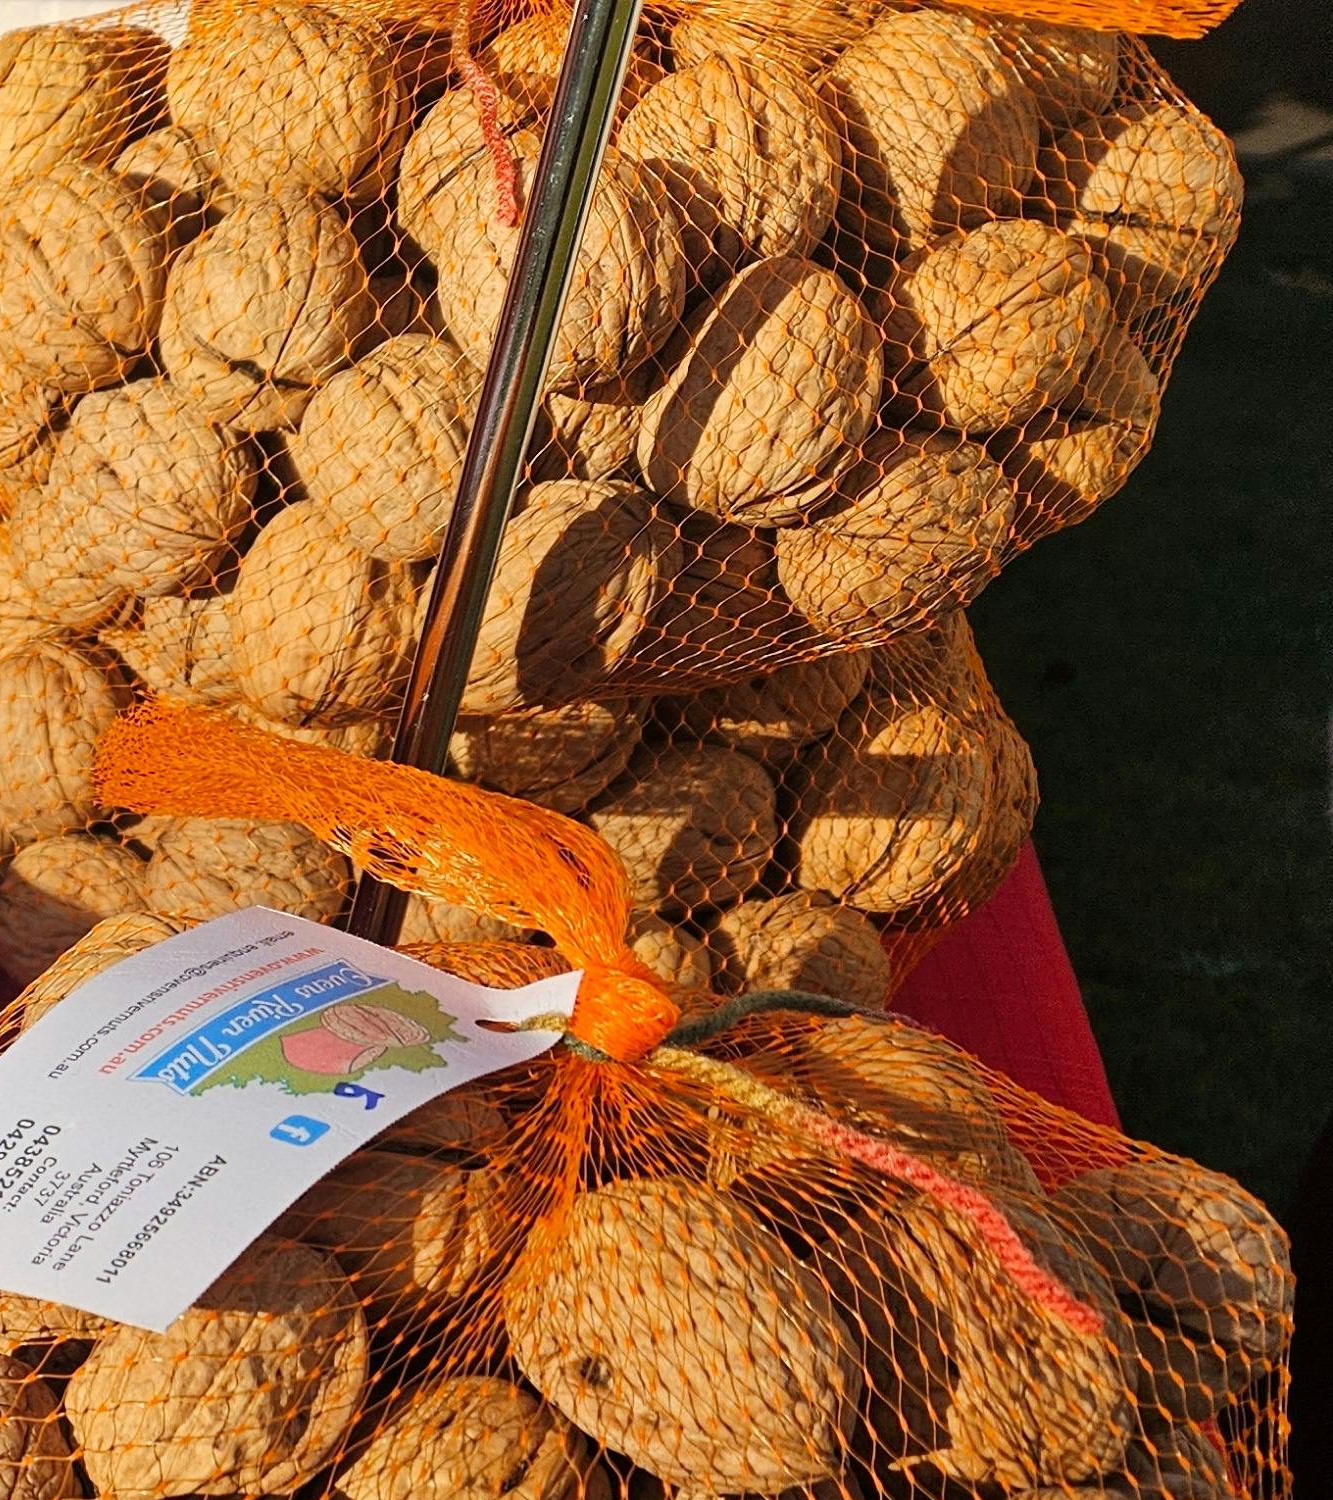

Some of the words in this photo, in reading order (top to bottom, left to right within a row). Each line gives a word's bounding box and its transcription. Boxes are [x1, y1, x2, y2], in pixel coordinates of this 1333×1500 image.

[294, 960, 374, 998] Ovens
[47, 941, 259, 1080] enquiries@ovensrivernuts.com.au
[98, 947, 325, 1075] www.ovensrivernuts.com.au
[221, 995, 306, 1038] River
[156, 1035, 233, 1084] Nuts
[2, 1156, 58, 1214] Contact:
[80, 1136, 160, 1207] Myrtleford,
[147, 1144, 180, 1170] 106
[33, 1170, 71, 1208] 3737
[40, 1162, 103, 1225] Australia
[87, 1170, 156, 1233] Toniazzo
[31, 1210, 90, 1267] Victoria
[95, 1153, 228, 1286] ABN:34925668011
[52, 1234, 95, 1272] Lane
